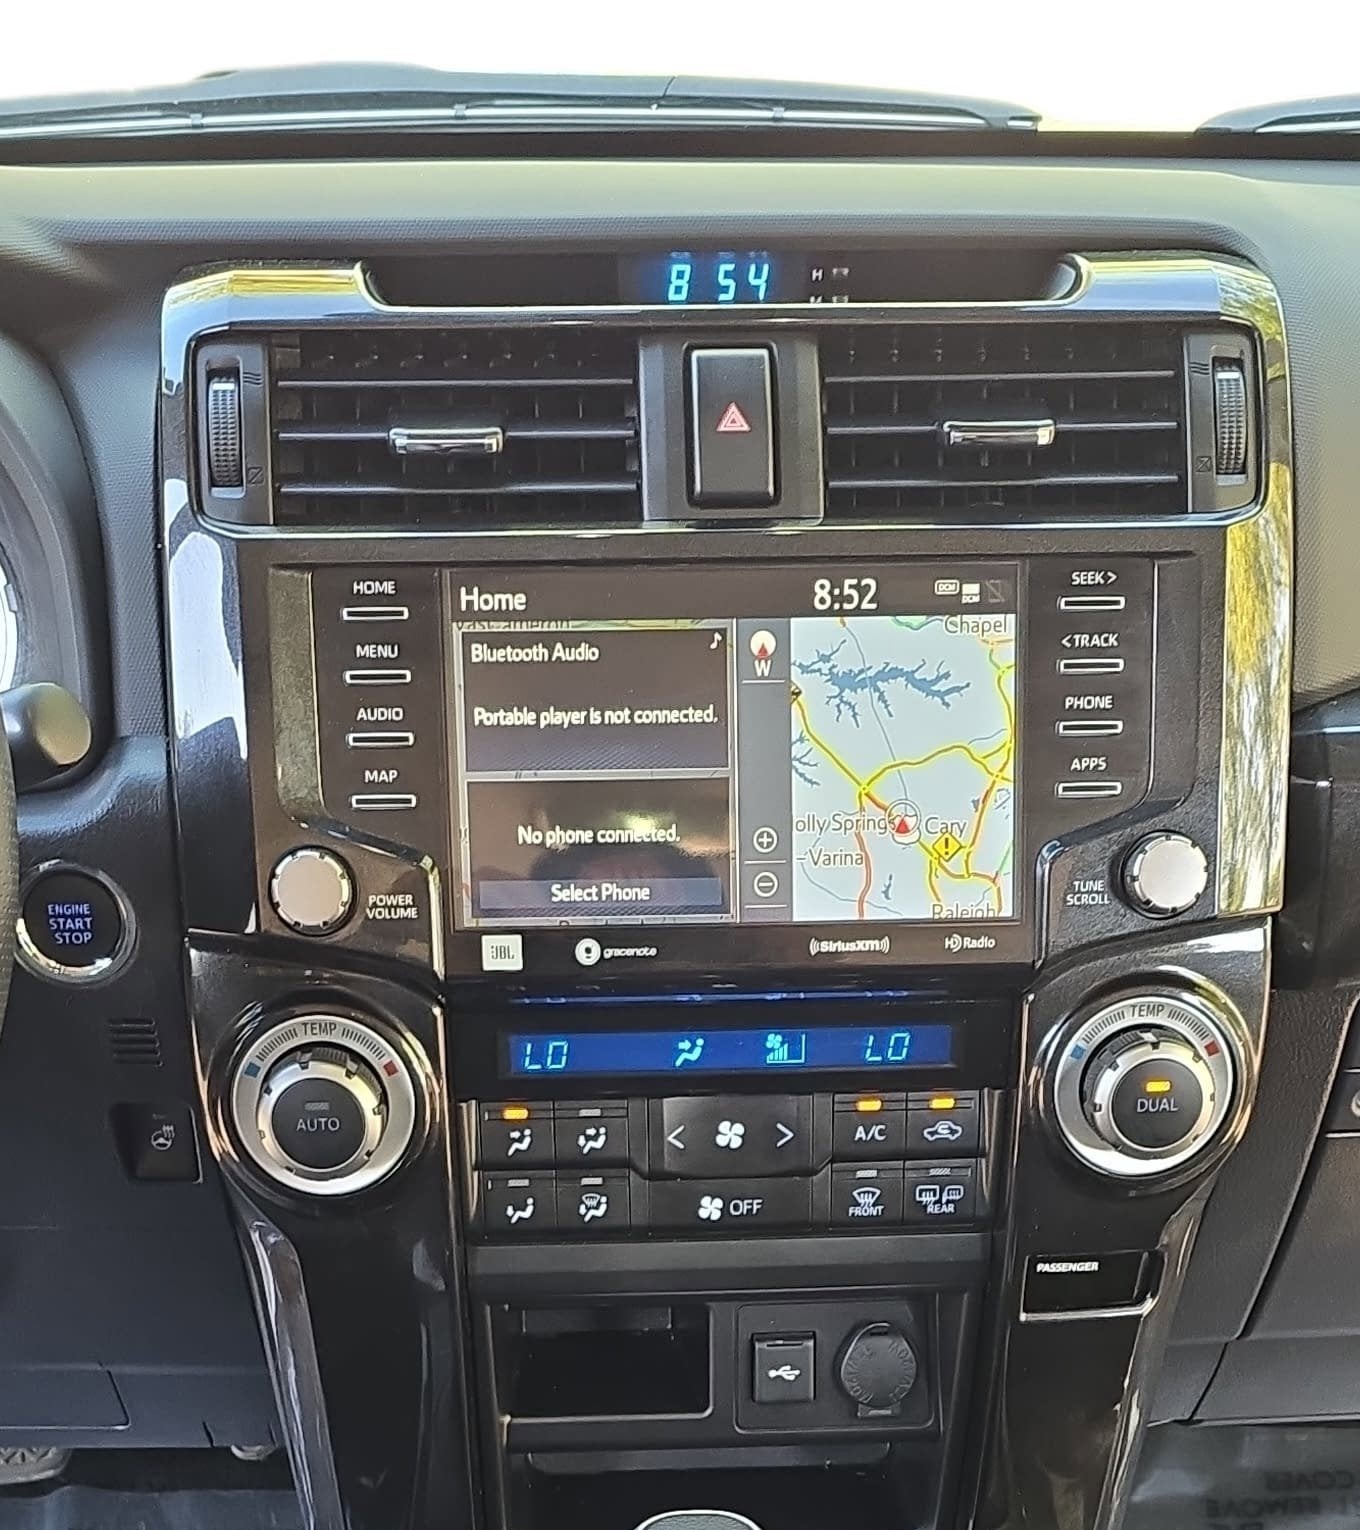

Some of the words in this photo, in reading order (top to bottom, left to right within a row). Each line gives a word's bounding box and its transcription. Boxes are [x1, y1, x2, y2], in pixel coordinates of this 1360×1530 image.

[352, 580, 396, 596] HOME
[812, 578, 879, 611] 8:52
[459, 586, 528, 612] Home
[944, 615, 1008, 637] Chapel
[355, 644, 399, 659] MENU
[470, 642, 550, 663] Bluetooth
[552, 642, 600, 662] Audio
[754, 660, 772, 678] W
[1064, 695, 1114, 710] PHONE
[356, 707, 404, 722] AUDIO
[473, 706, 537, 726] Portable
[540, 707, 587, 729] player
[590, 706, 602, 724] is
[604, 707, 631, 724] not
[633, 703, 719, 724] connected.
[1070, 757, 1107, 772] APPS
[364, 769, 399, 784] MAP
[795, 814, 827, 836] olly
[831, 813, 896, 836] Springs
[924, 816, 967, 837] Cary
[517, 824, 544, 845] No
[546, 825, 593, 848] phone
[597, 823, 681, 844] connected.
[550, 883, 598, 903] Select
[601, 882, 650, 902] Phone
[1072, 880, 1105, 893] TUNE
[368, 894, 414, 907] POWER
[1066, 893, 1111, 906] SCROLL
[47, 903, 91, 916] ENGINE
[365, 907, 419, 920] VOLUME
[48, 918, 93, 931] START
[54, 932, 93, 945] STOP
[962, 935, 996, 949] Radio
[490, 944, 516, 961] JBL
[603, 945, 658, 961] gracenote
[1129, 1004, 1166, 1020] TEMP
[301, 1021, 337, 1037] TEMP
[1136, 1097, 1179, 1113] DUAL
[295, 1117, 341, 1132] AUTO
[853, 1124, 888, 1142] A/C
[729, 1199, 763, 1216] OFF
[848, 1205, 885, 1217] FRONT
[926, 1203, 956, 1214] REAR
[1035, 1261, 1100, 1273] PASSENGER
